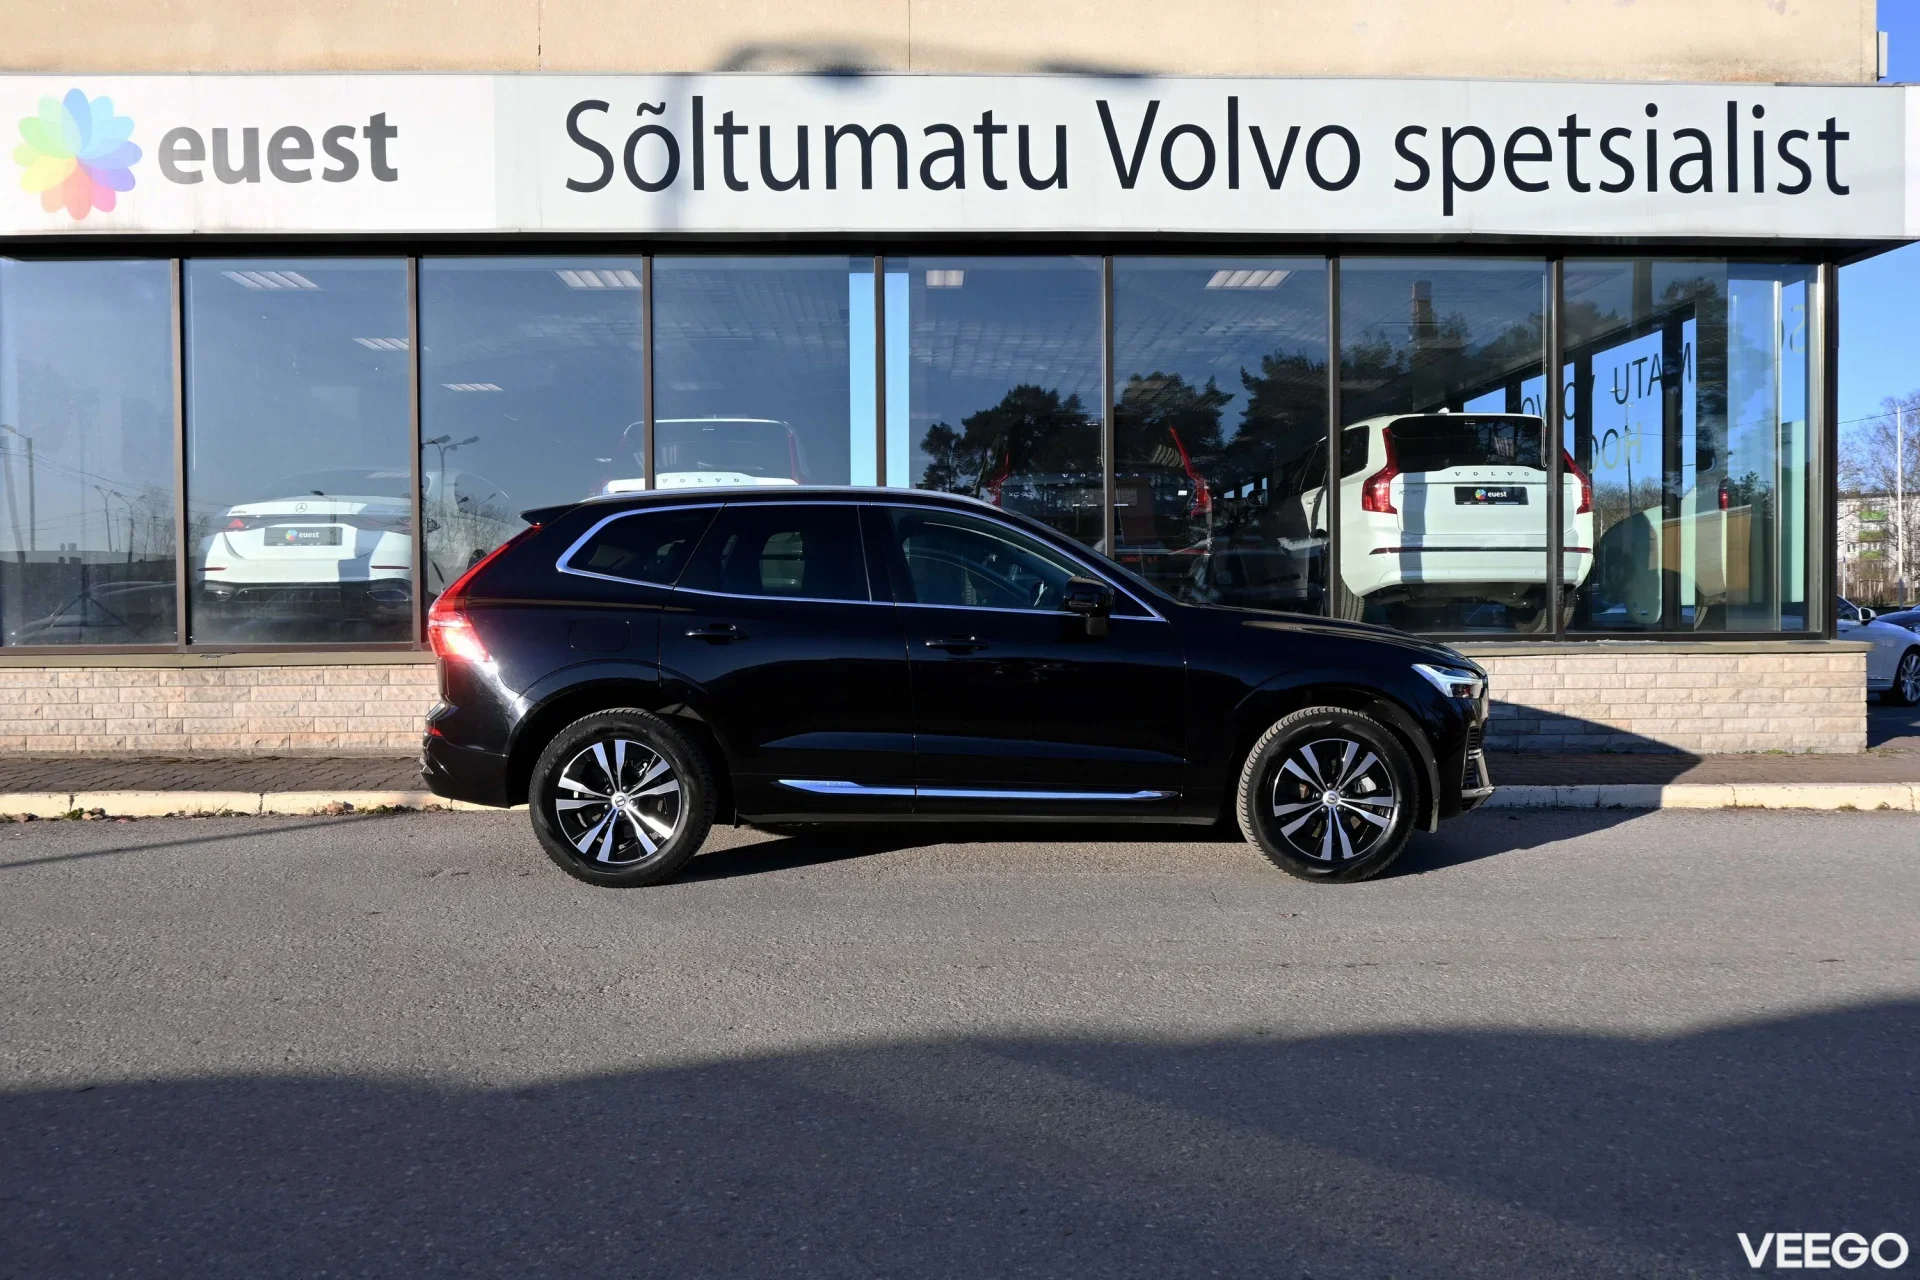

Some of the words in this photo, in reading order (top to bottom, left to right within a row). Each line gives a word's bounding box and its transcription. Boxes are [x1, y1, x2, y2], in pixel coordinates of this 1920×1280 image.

[158, 111, 398, 184] euest
[566, 95, 1068, 193] Sõltumatu
[1095, 95, 1361, 192] Volvo
[1393, 100, 1850, 217] spetsialist
